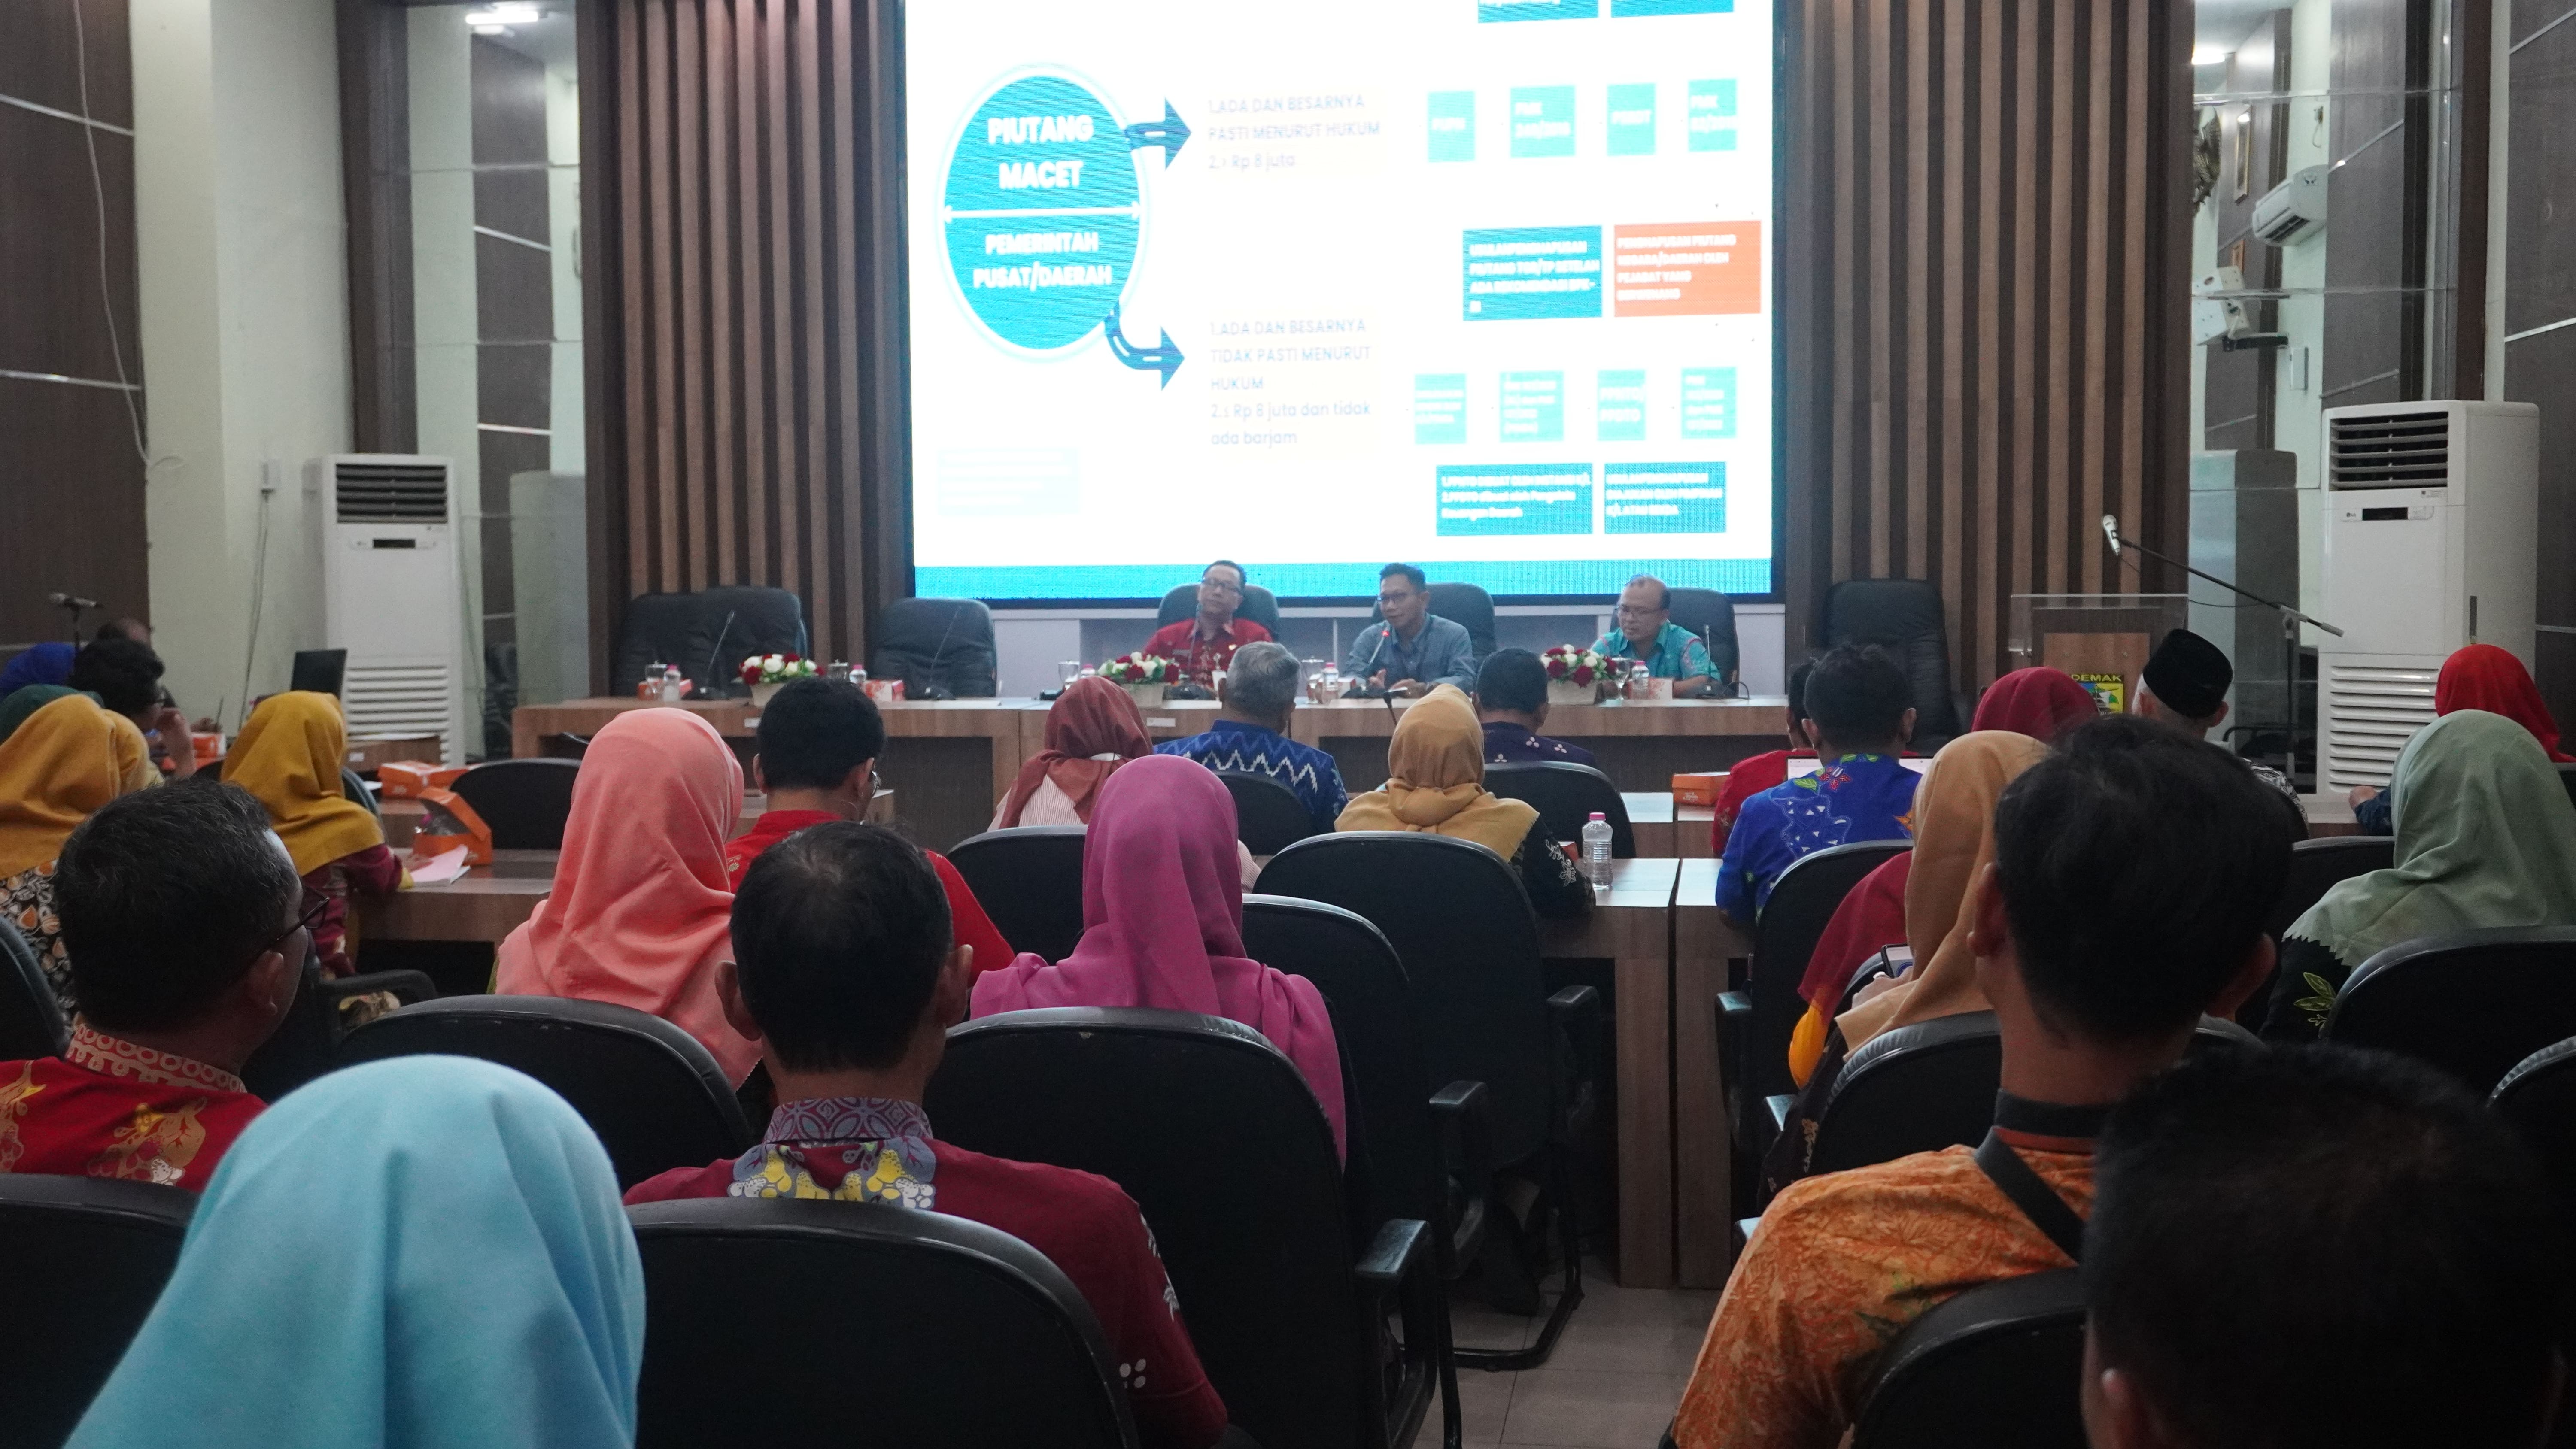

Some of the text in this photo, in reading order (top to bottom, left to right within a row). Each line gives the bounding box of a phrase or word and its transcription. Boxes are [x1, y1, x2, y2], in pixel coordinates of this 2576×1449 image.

[1252, 98, 1283, 112] DAN
[1288, 94, 1364, 111] BESARNYA
[987, 115, 1094, 144] PIUTANG
[1209, 121, 1380, 140] PASTI MENURUT HUKUM
[1232, 155, 1250, 173] Rp
[1255, 152, 1262, 168] 8
[1266, 152, 1295, 172] juta
[999, 161, 1083, 189] MACET
[985, 232, 1098, 255] PEMERINTAH
[973, 261, 1112, 291] PUSAT/DAERAH
[1255, 321, 1285, 335] DAN
[1290, 319, 1366, 333] BESARNYA
[1211, 345, 1371, 363] TIDAK PASTI MENURUT
[1211, 376, 1264, 391] HUKUM
[1233, 404, 1252, 422] Rp
[1256, 403, 1264, 417] 8
[1267, 402, 1297, 422] juta
[1301, 402, 1329, 417] dan
[1333, 400, 1370, 415] tidak
[1212, 430, 1297, 449] ada barjam
